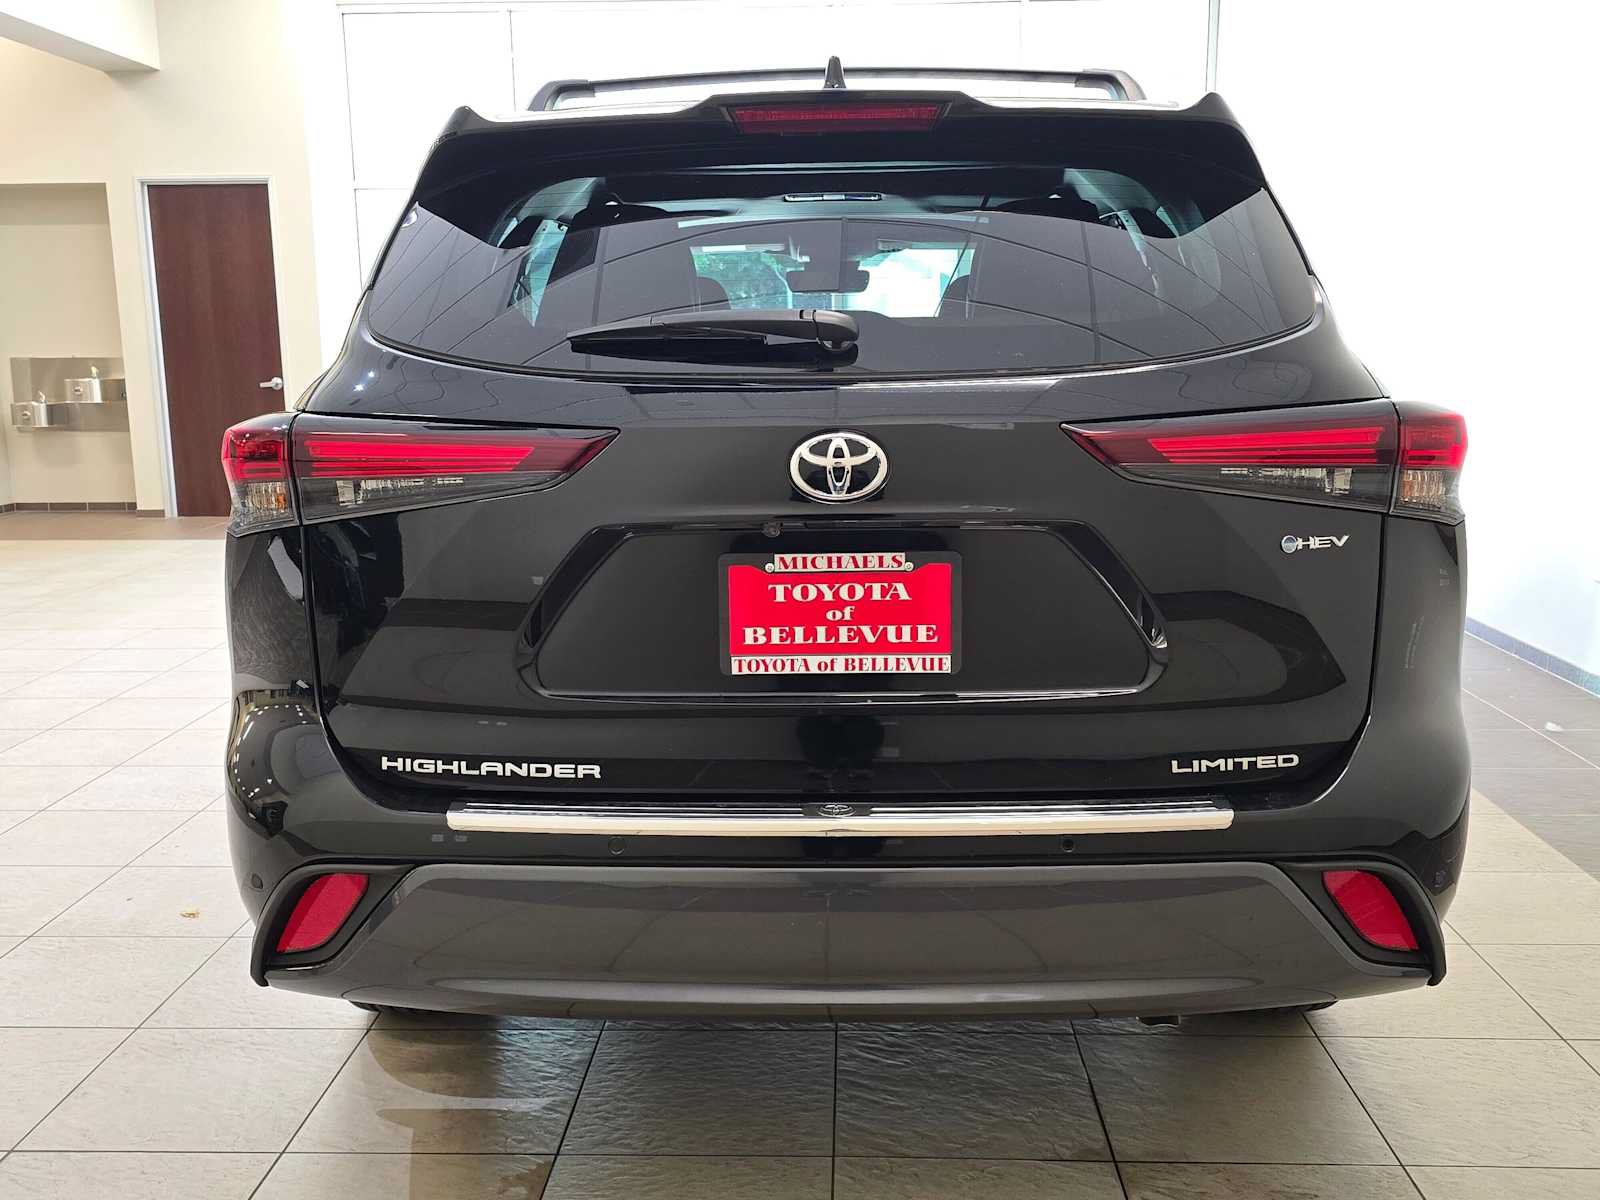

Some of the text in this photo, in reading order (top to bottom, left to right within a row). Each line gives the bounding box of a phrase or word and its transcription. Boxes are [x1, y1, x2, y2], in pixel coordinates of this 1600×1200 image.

[778, 554, 904, 570] MICHAELS
[768, 582, 912, 602] TOYOTA
[825, 606, 855, 621] of
[743, 624, 939, 645] BELLEVUE
[733, 656, 950, 673] TOYOTA of BELLEVUE
[381, 756, 602, 779] HIGHLANDER
[1171, 753, 1299, 774] LIMITED
